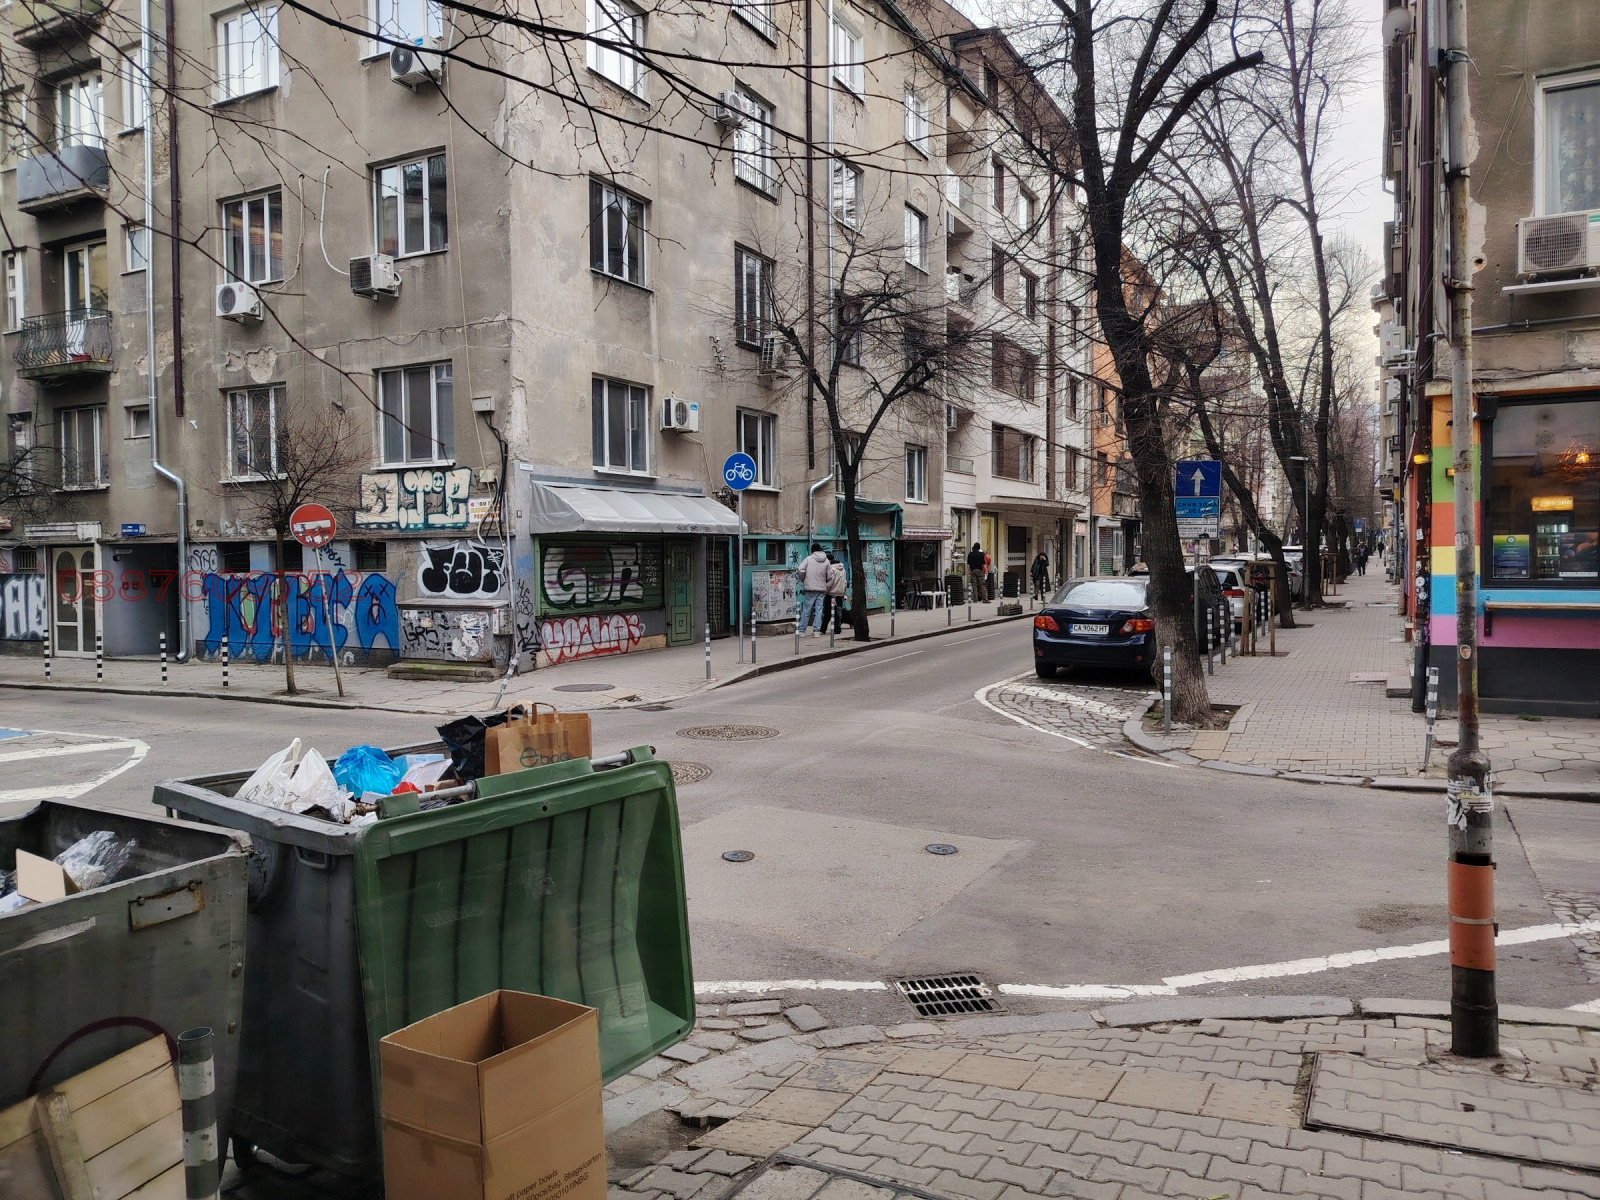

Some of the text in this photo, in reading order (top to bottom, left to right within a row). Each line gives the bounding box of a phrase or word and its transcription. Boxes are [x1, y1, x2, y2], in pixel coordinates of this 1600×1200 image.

[1073, 624, 1082, 632] CA
[563, 1152, 602, 1182] 6bags/carton
[516, 1181, 537, 1200] paper
[538, 1169, 559, 1185] bowls
